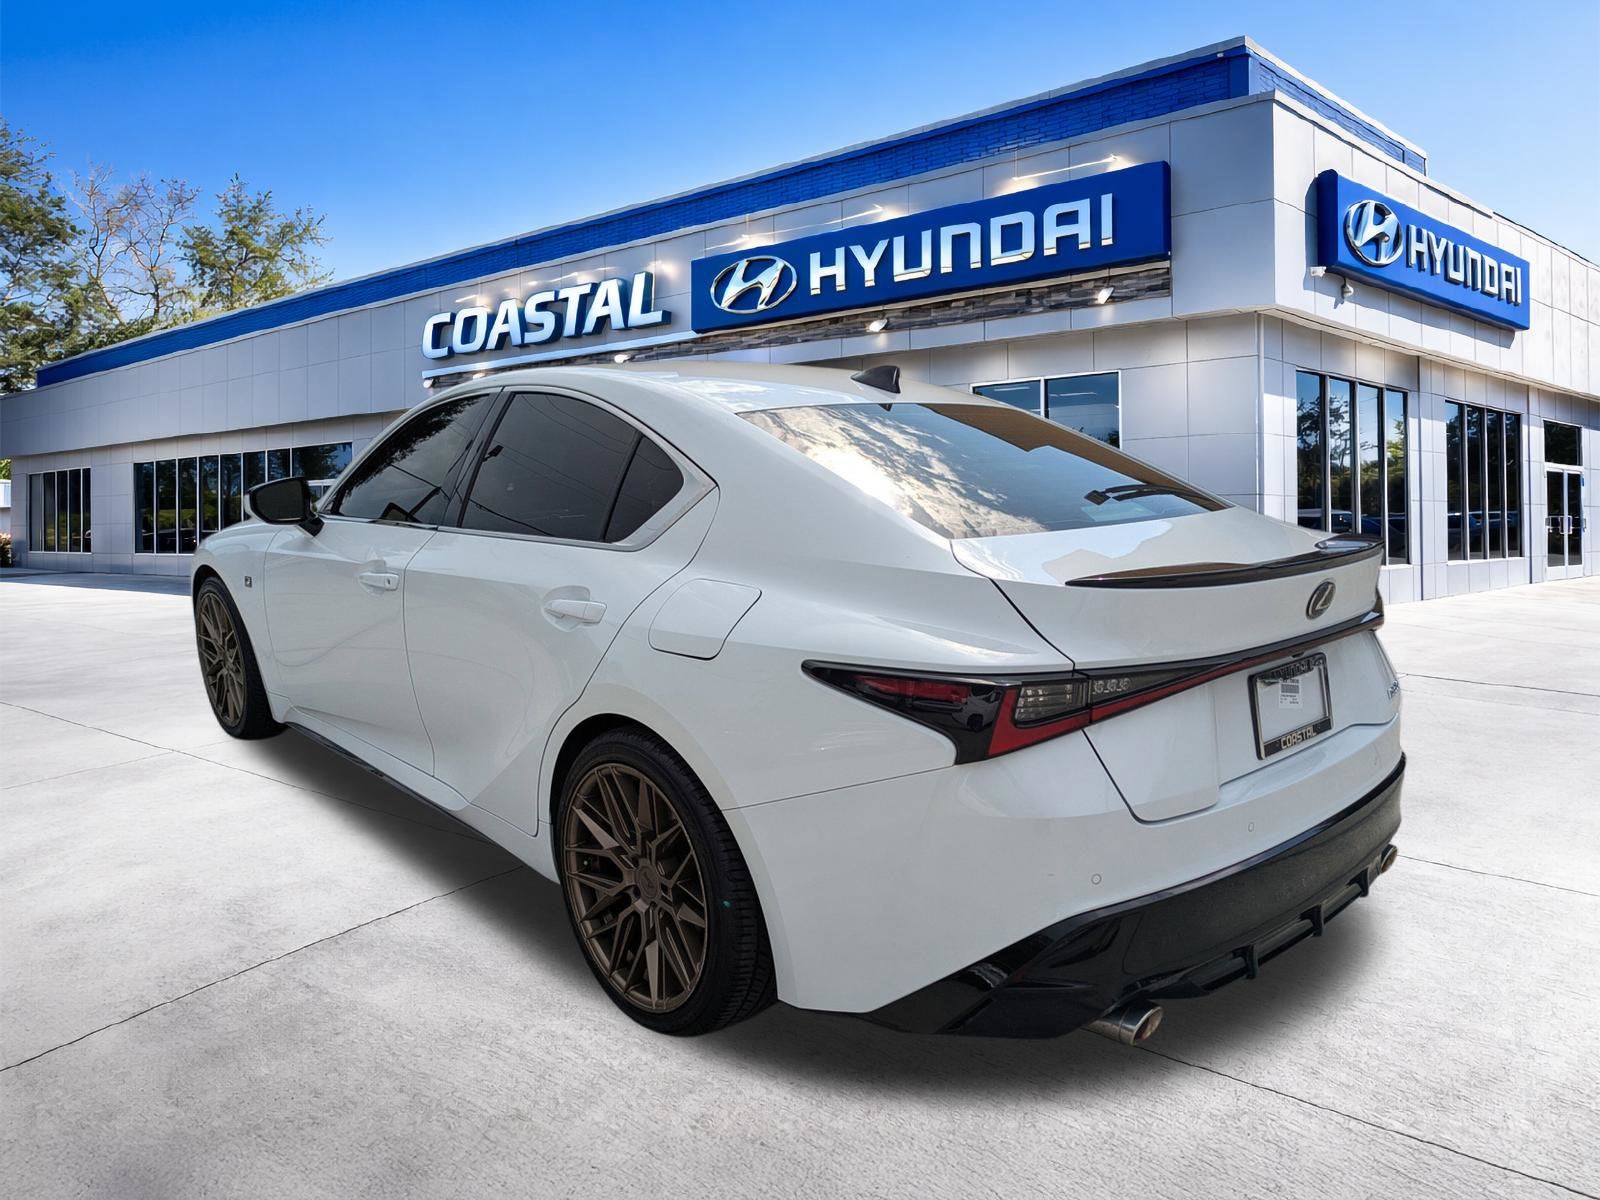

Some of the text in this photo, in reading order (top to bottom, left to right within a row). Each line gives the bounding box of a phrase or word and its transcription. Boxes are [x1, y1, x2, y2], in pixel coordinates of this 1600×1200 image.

[810, 193, 1113, 296] HYUNDAI
[1406, 224, 1522, 306] HYUNDAI
[422, 271, 668, 359] COASTAL
[1280, 726, 1317, 750] COASTAL
